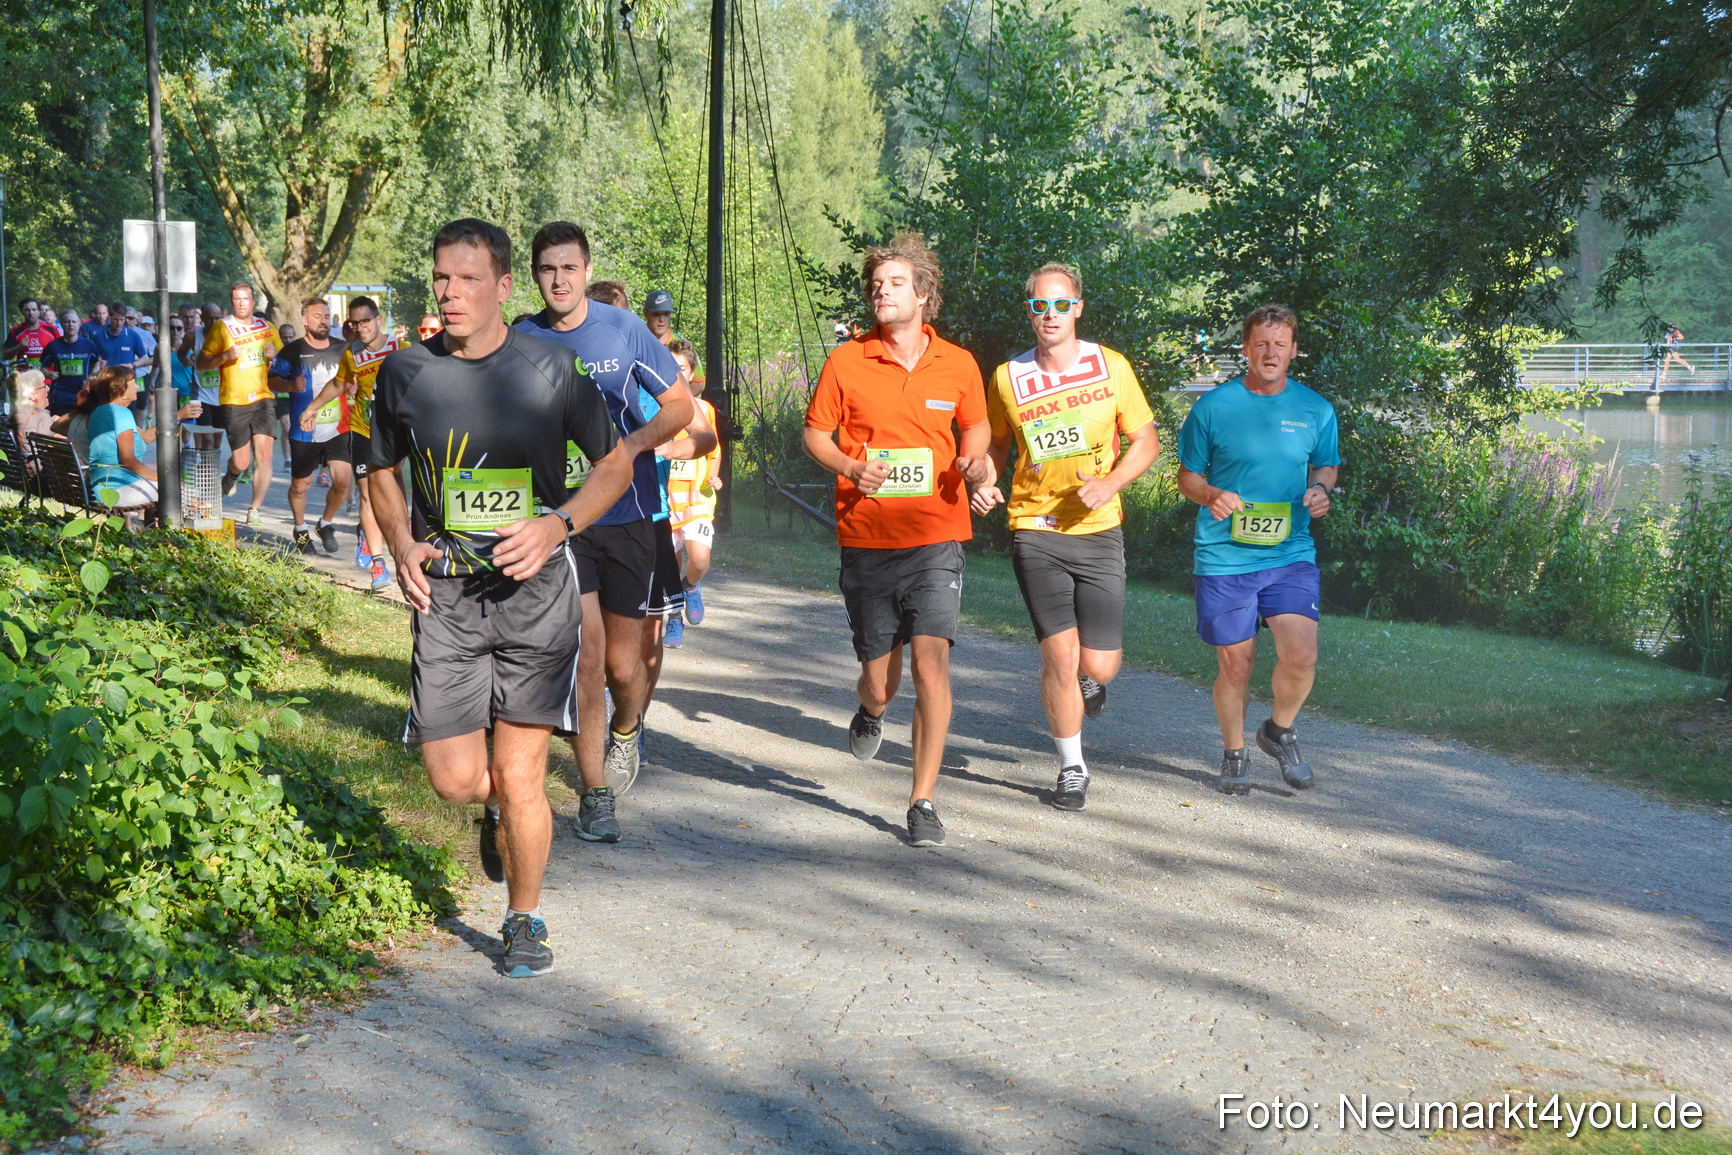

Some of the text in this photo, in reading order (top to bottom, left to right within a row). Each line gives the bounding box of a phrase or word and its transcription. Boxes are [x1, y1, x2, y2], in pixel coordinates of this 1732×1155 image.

[235, 338, 253, 346] MAX
[357, 366, 376, 377] MAX
[587, 358, 620, 374] OLES
[1018, 387, 1114, 423] MAX BÖGL
[1034, 426, 1080, 450] 1235
[356, 463, 367, 474] 42
[886, 465, 924, 483] 485
[455, 490, 520, 512] 1422
[697, 523, 710, 537] 10
[1240, 515, 1284, 533] 1527
